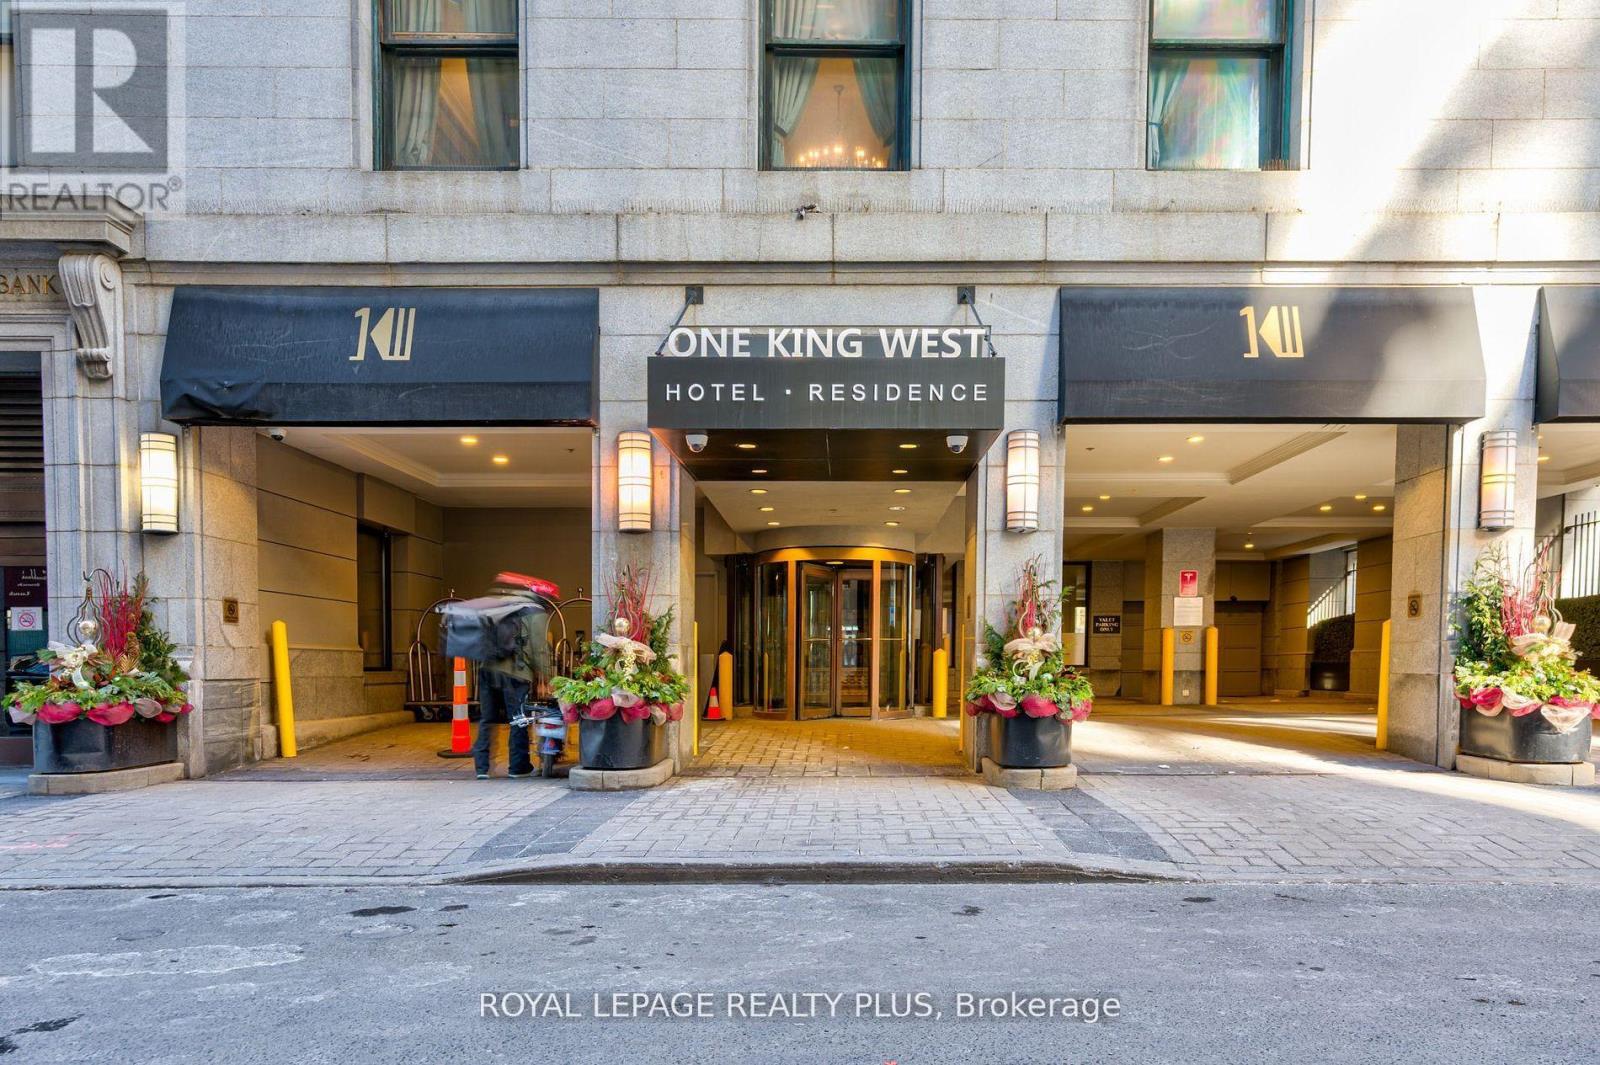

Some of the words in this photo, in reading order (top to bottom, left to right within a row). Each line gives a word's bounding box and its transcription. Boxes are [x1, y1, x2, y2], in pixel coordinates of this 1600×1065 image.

[667, 327, 751, 358] ONE
[768, 327, 863, 358] KING
[879, 328, 987, 358] WEST
[666, 383, 765, 402] HOTEL
[808, 383, 988, 402] RESIDENCE
